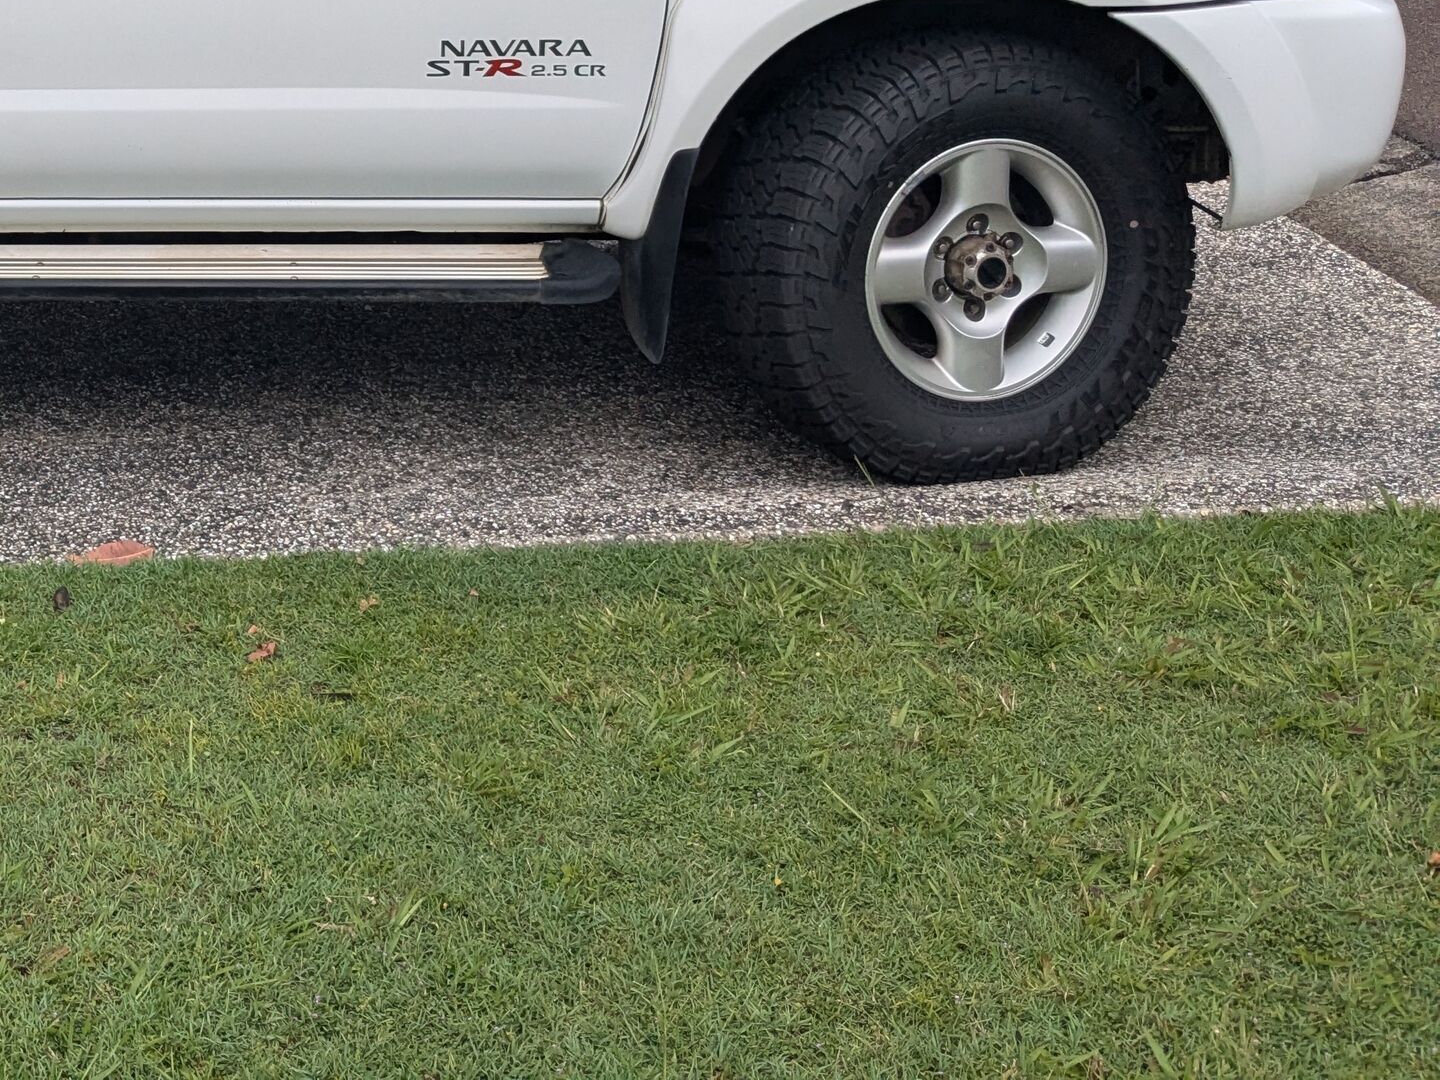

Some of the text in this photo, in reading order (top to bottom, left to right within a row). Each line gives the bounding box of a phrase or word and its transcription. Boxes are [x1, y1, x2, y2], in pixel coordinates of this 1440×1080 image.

[440, 39, 593, 58] NAVARA
[531, 64, 568, 77] 2.5
[573, 64, 607, 77] CR
